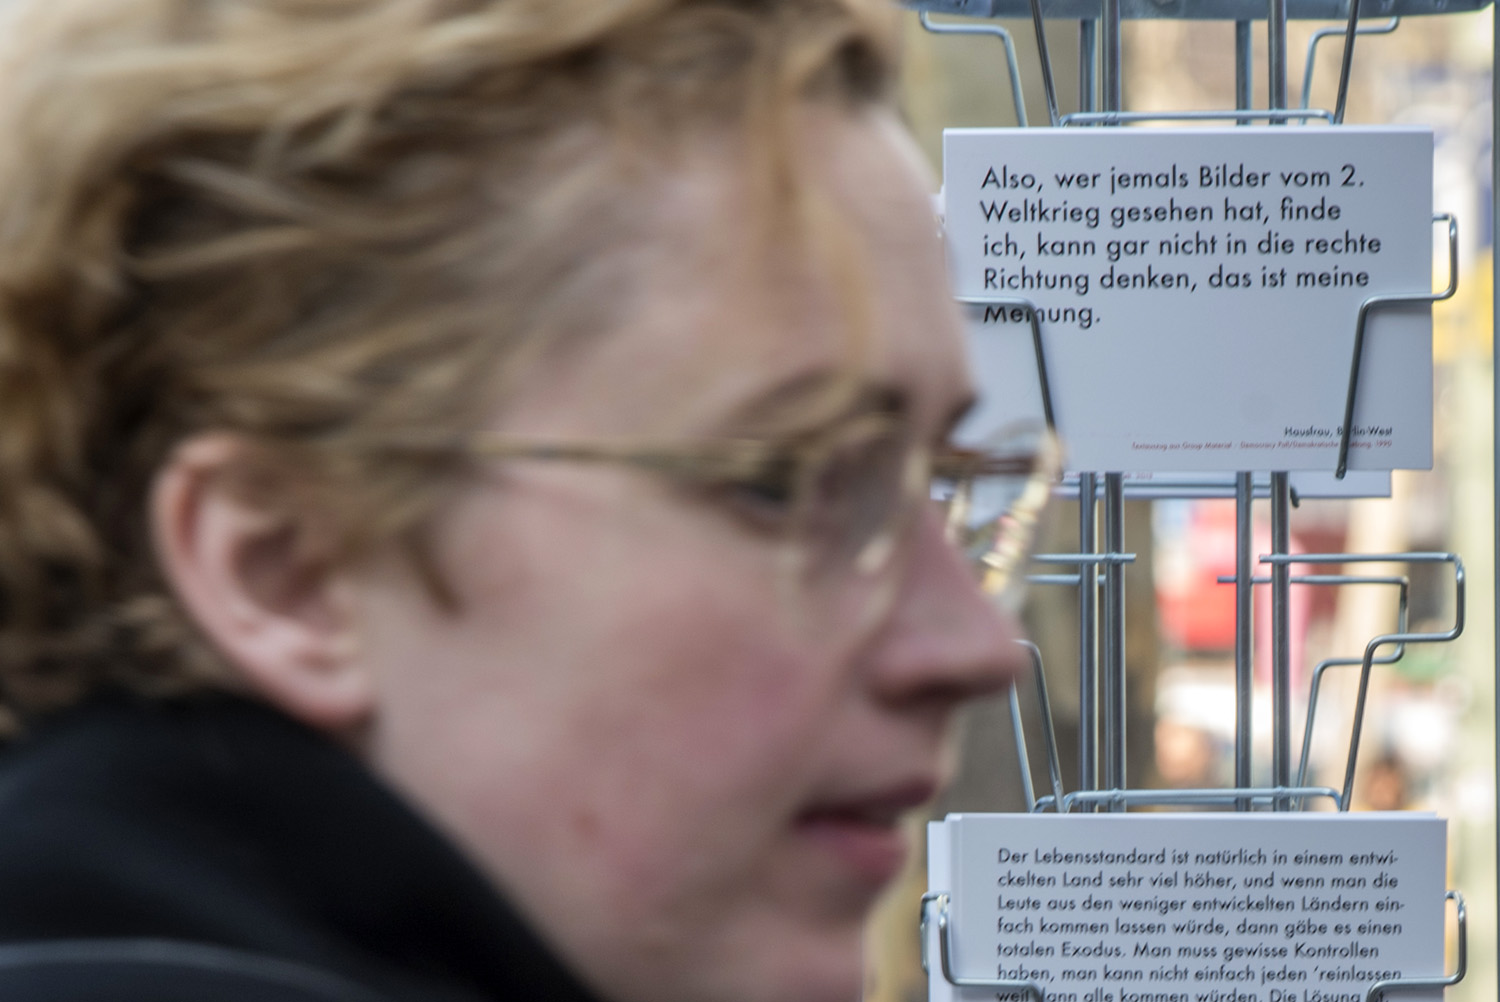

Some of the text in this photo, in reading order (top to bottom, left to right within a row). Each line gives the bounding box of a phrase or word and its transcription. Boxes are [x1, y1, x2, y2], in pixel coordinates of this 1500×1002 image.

[981, 163, 1363, 195] Also, wer jemals Bilder vom 2.
[980, 196, 1341, 229] Weltkrieg gesehen hat, finde
[984, 230, 1381, 262] ich, kann gar nicht in die rechte
[985, 264, 1369, 296] Richtung denken, das ist meine
[998, 847, 1398, 865] Der Lebensstandard ist natürlich in einem entwi-
[998, 870, 1398, 890] ckelten Land sehr viel höher, und wenn man die
[998, 894, 1404, 915] Leute aus den weniger entwickelten Ländern ein-
[998, 916, 1402, 939] fach kommen lassen würde, dann gäbe es einen
[997, 940, 1378, 962] totalen Exodus. Man muss gewisse Kontrollen
[1062, 970, 1097, 980] man
[1104, 964, 1143, 980] kann
[1149, 964, 1189, 981] nicht
[1195, 964, 1255, 981] einfach
[1262, 965, 1307, 985] jeden
